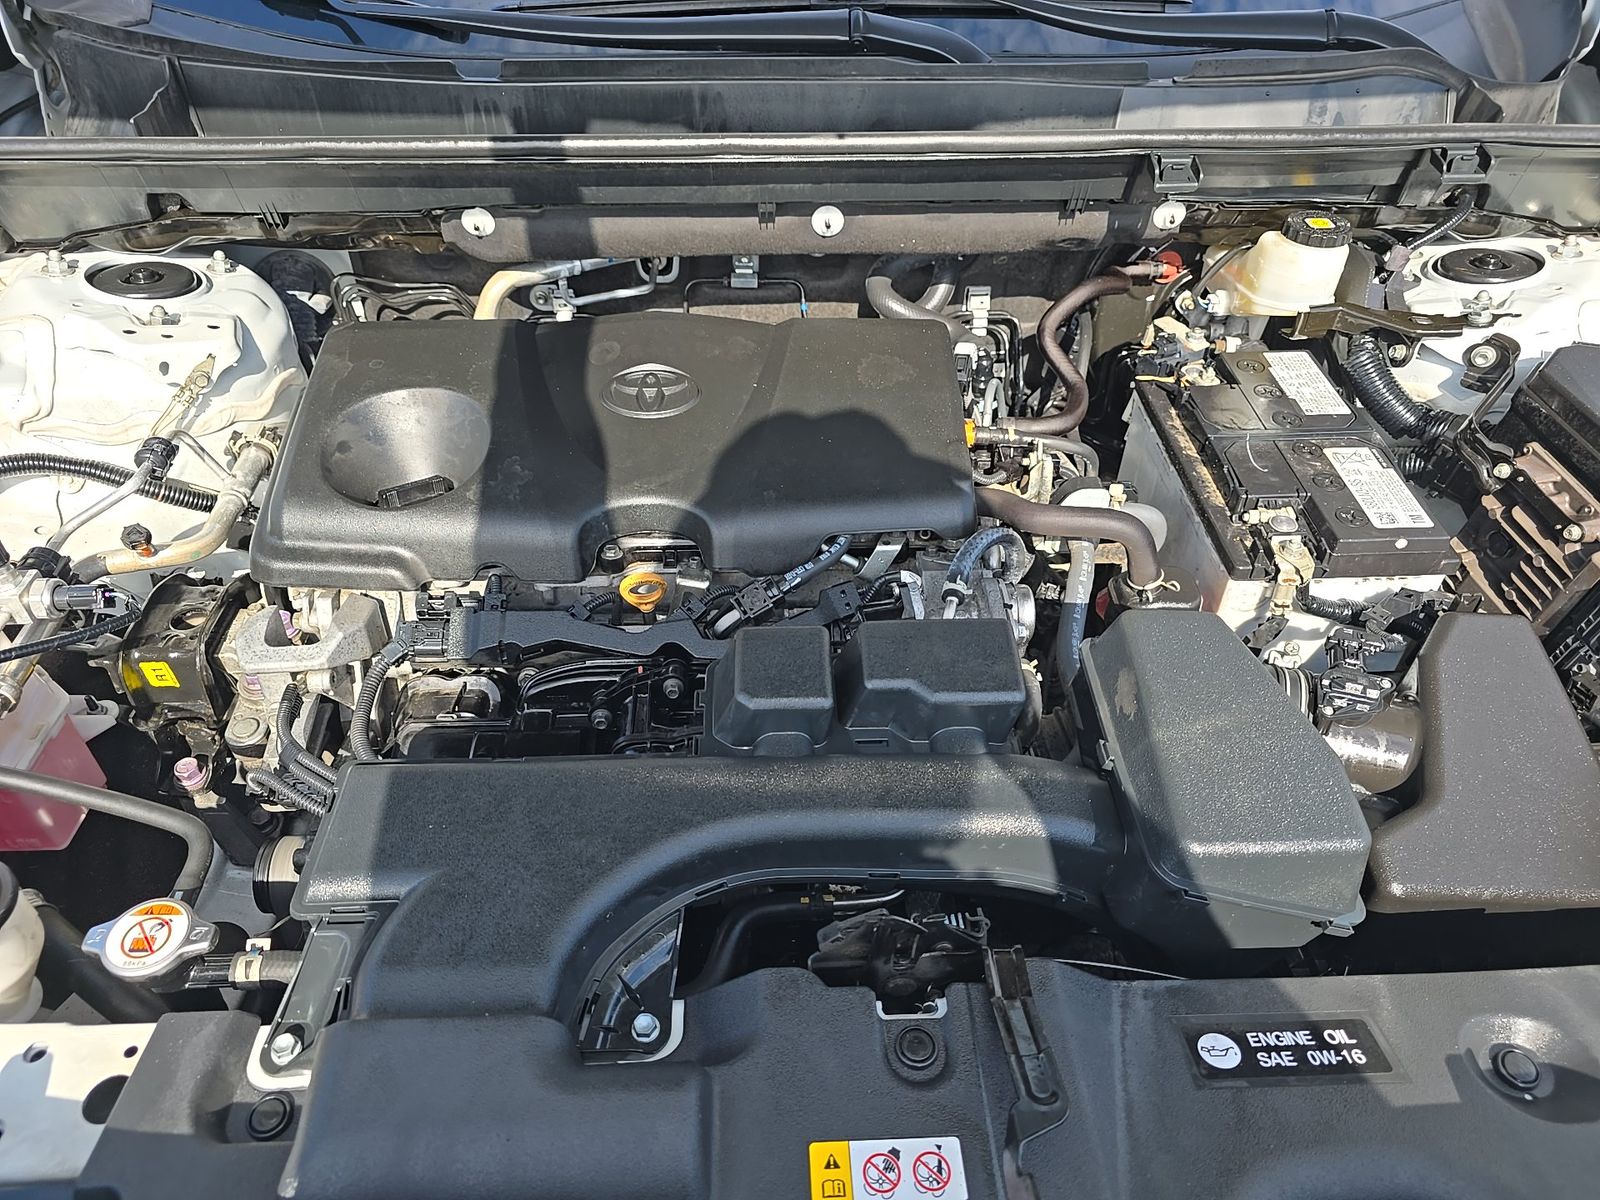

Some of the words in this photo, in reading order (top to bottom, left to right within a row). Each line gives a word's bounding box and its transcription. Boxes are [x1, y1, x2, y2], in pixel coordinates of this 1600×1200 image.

[1246, 1031, 1316, 1047] ENGINE
[1323, 1029, 1358, 1045] OIL
[1256, 1051, 1298, 1068] SAE
[1306, 1049, 1367, 1066] 0W-16
